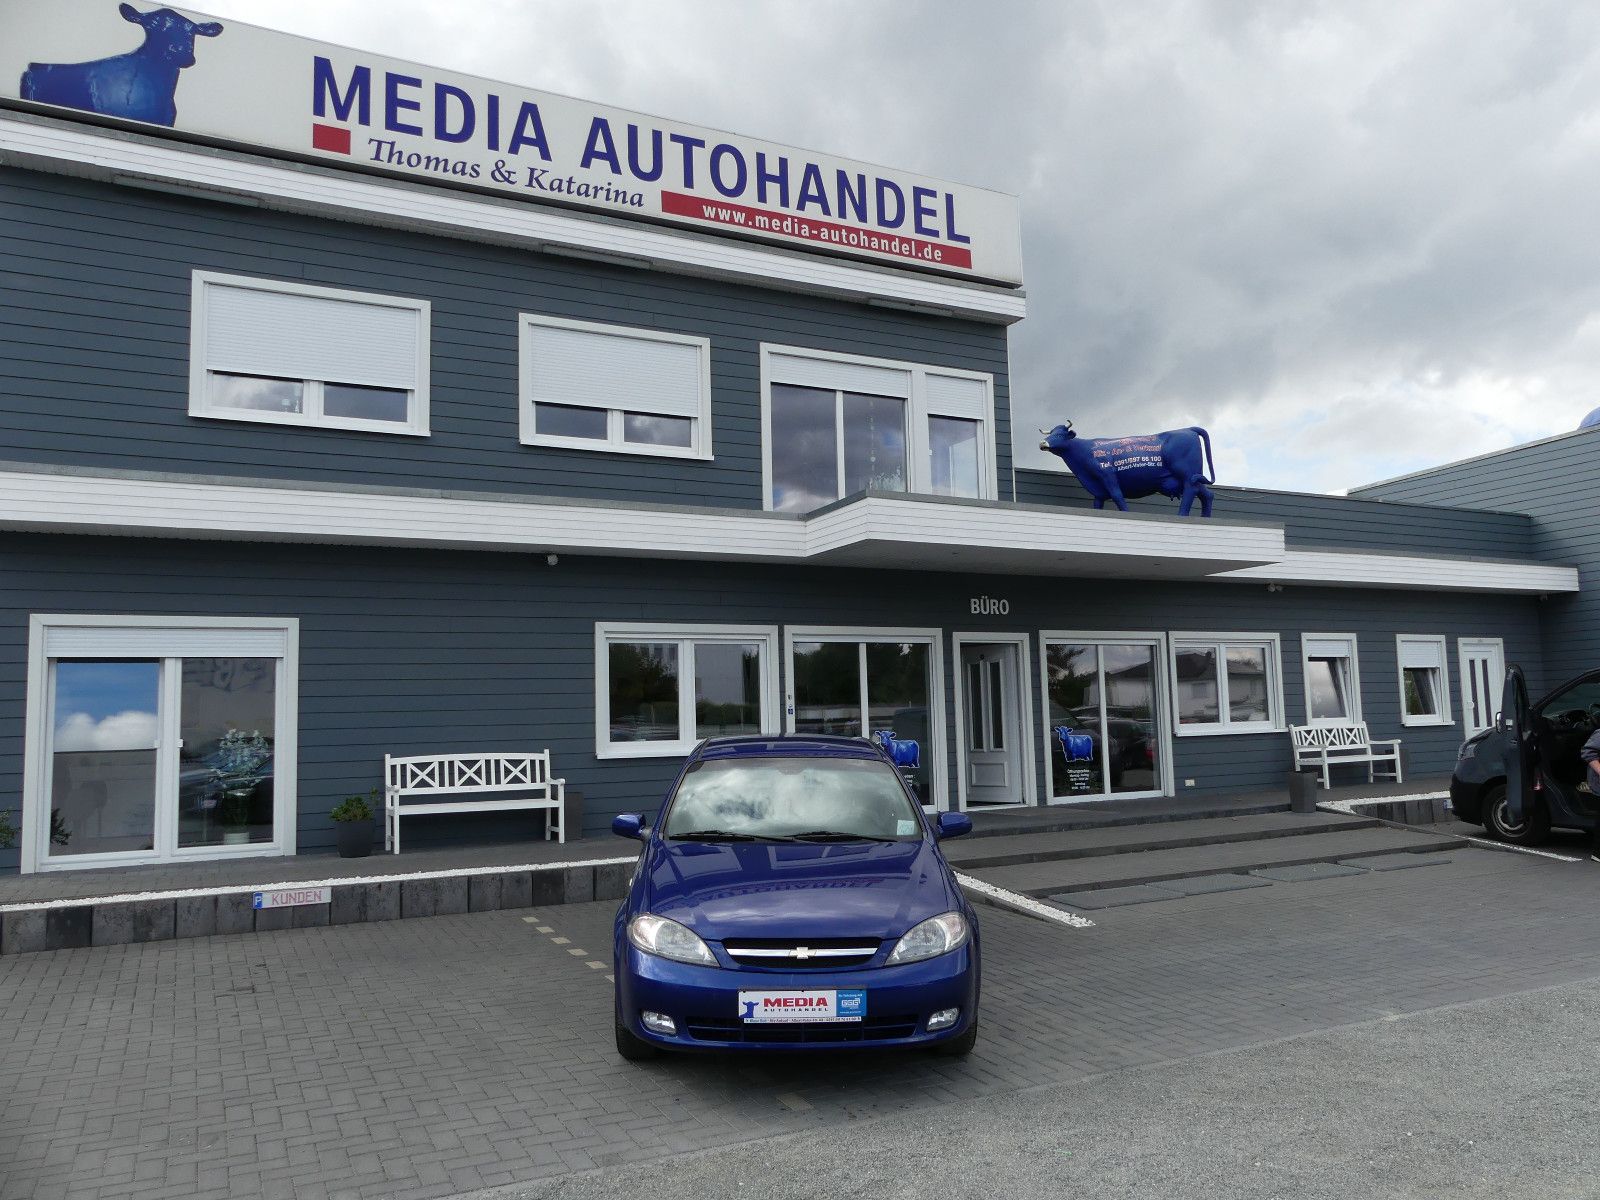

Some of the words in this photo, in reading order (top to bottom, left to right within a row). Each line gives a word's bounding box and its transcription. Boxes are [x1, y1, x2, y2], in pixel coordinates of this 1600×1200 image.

[312, 56, 551, 162] MEDIA
[580, 116, 971, 244] AUTOHANDEL
[367, 137, 481, 182] Thomas
[490, 158, 518, 184] &
[524, 167, 645, 209] Katarina
[702, 202, 943, 262] www.media-autohandel.de
[970, 595, 1010, 615] BÜRO
[271, 890, 322, 905] KUNDEN
[763, 997, 828, 1007] MEDIA
